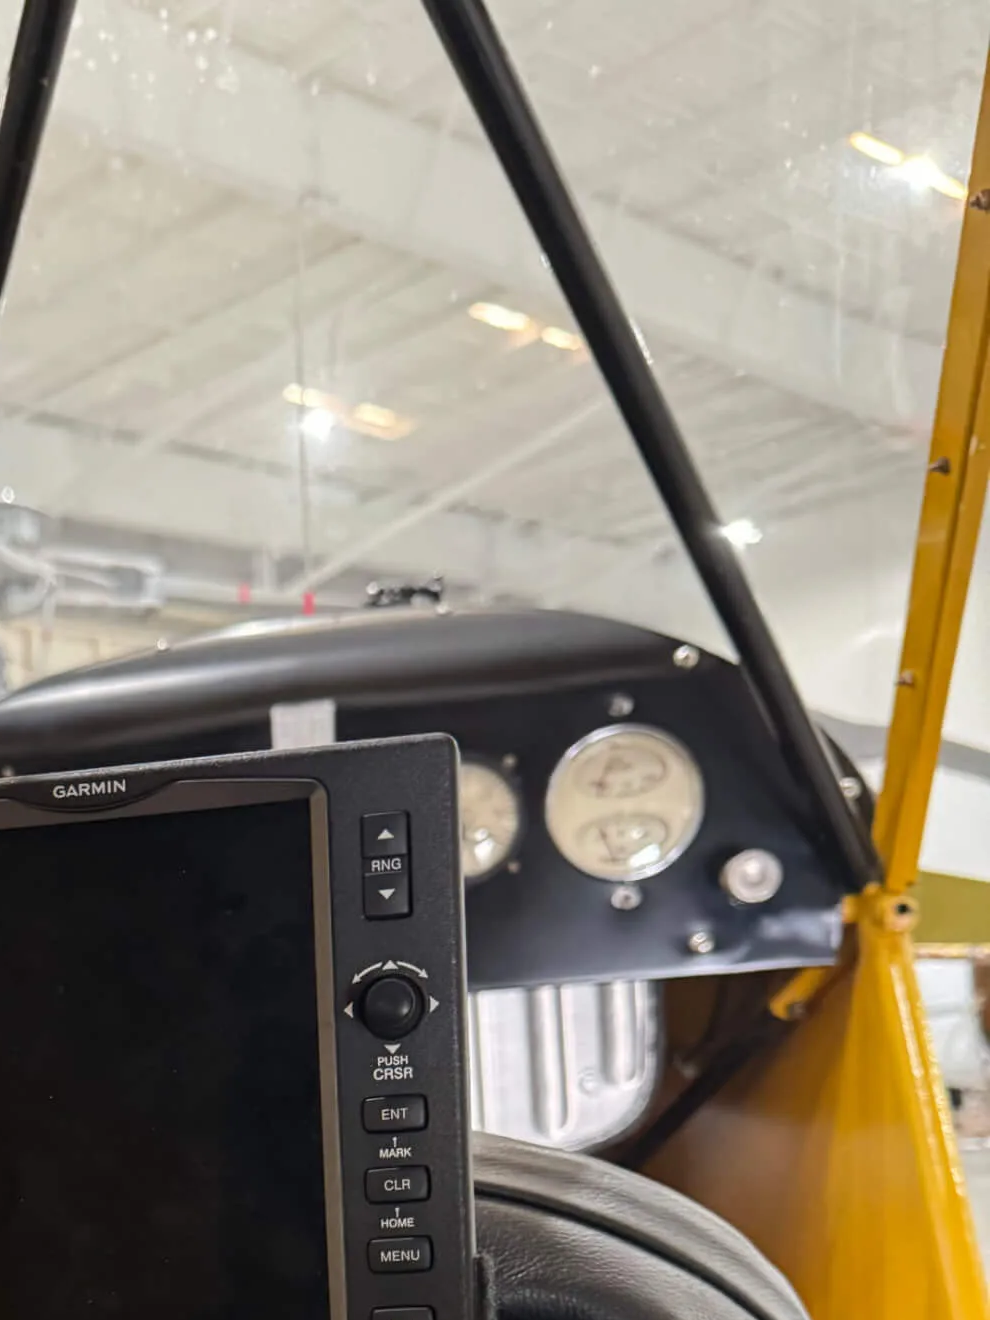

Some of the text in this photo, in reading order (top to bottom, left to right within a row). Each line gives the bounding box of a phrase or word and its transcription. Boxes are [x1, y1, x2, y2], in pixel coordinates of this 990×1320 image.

[53, 779, 126, 799] GARMIN
[371, 857, 402, 872] RNG
[377, 1055, 409, 1067] PUSH
[373, 1067, 413, 1080] CRSR
[381, 1107, 408, 1121] ENT
[379, 1147, 412, 1159] MARK
[384, 1178, 411, 1191] CLR
[380, 1217, 414, 1229] HOME
[380, 1250, 420, 1262] MENU
